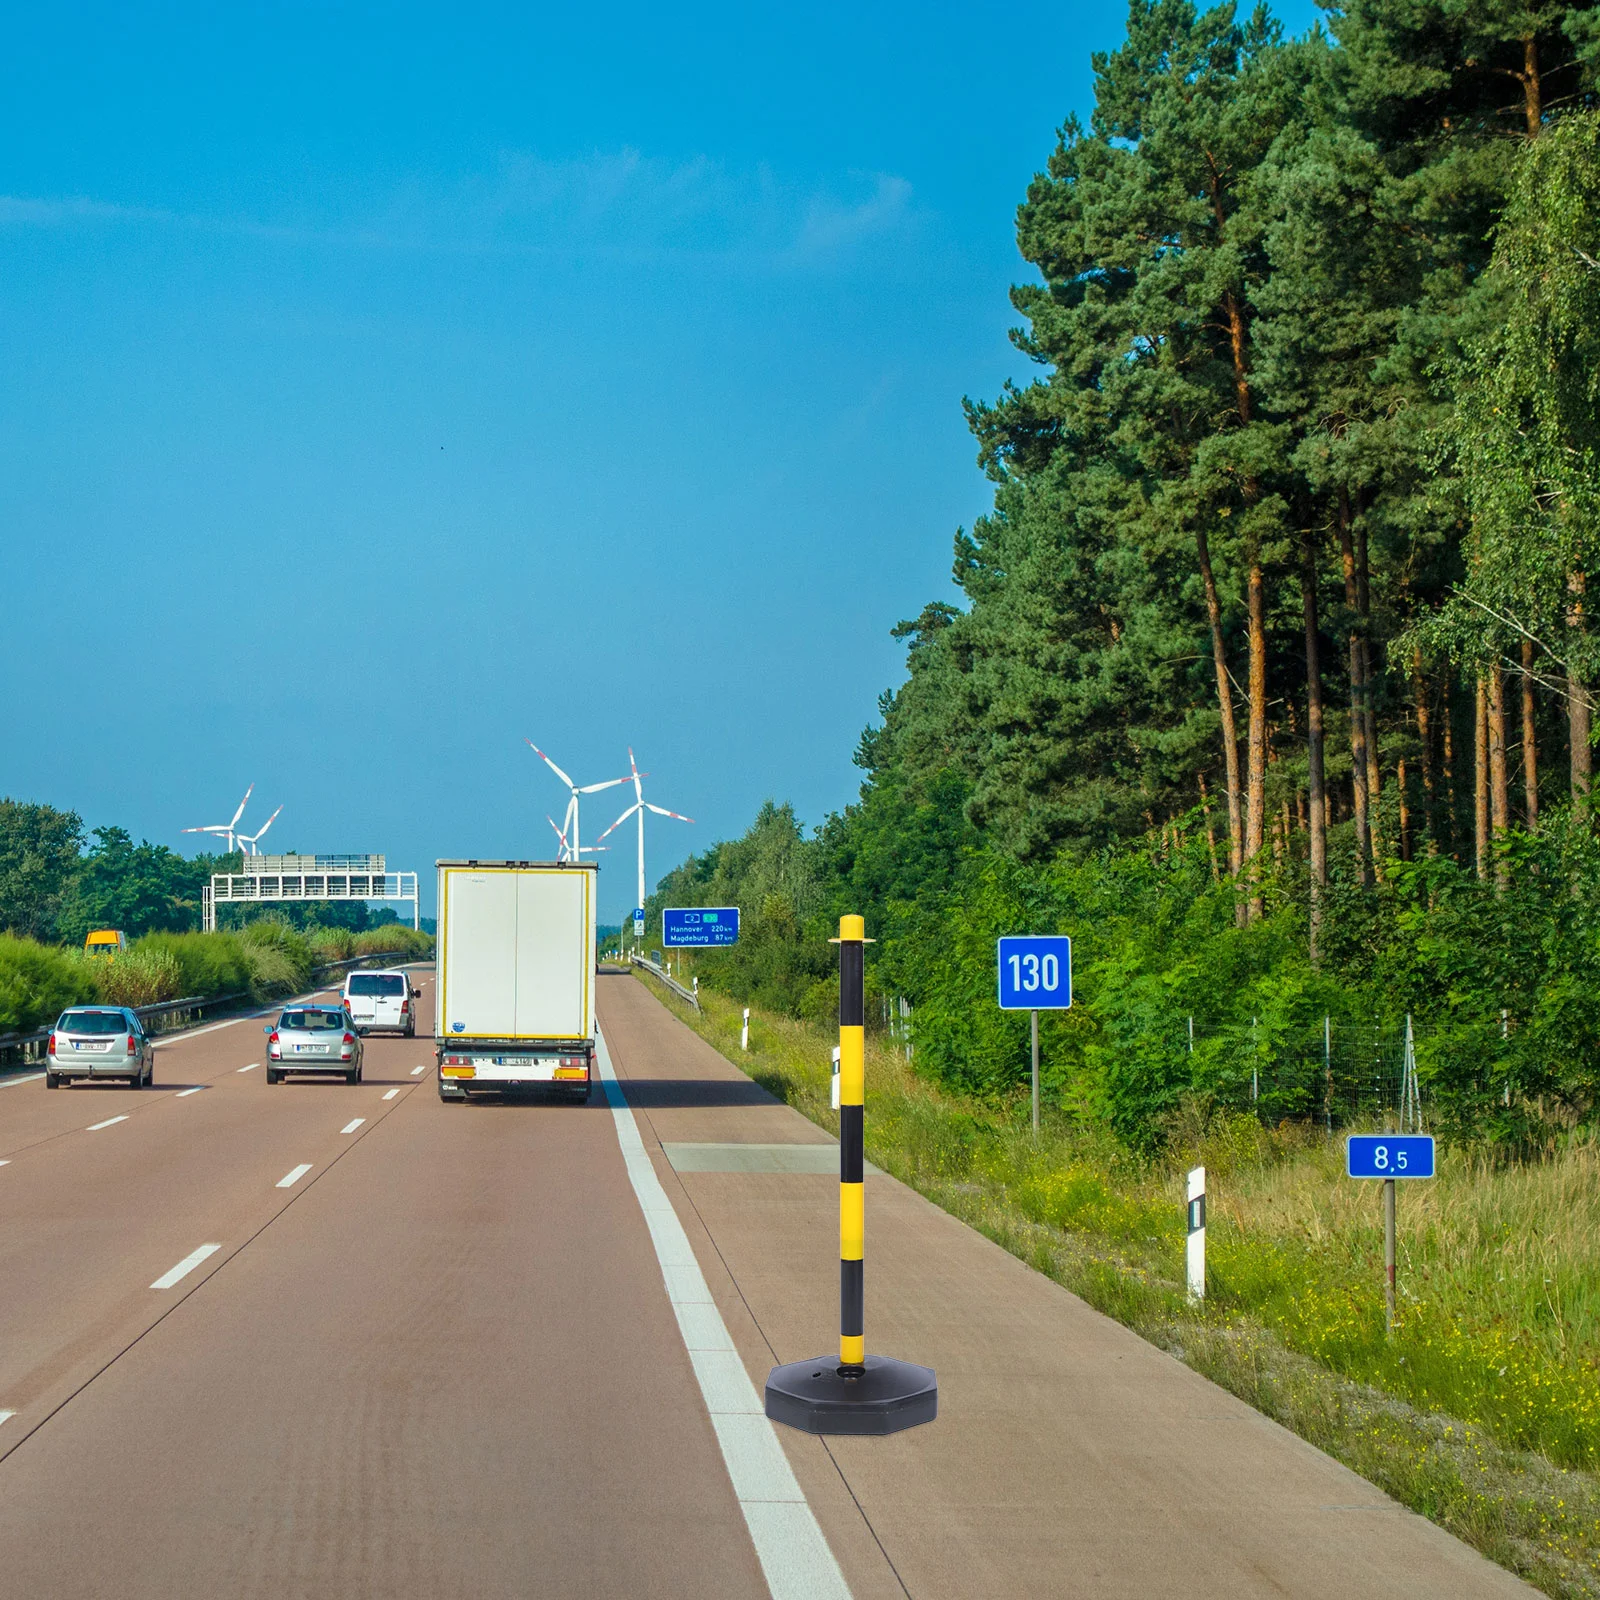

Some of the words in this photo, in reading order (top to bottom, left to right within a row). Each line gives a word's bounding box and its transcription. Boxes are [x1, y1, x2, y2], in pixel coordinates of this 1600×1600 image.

[635, 910, 642, 919] P
[670, 935, 709, 943] Magdeburg
[1008, 953, 1059, 992] 130
[1374, 1145, 1408, 1173] 8,5
